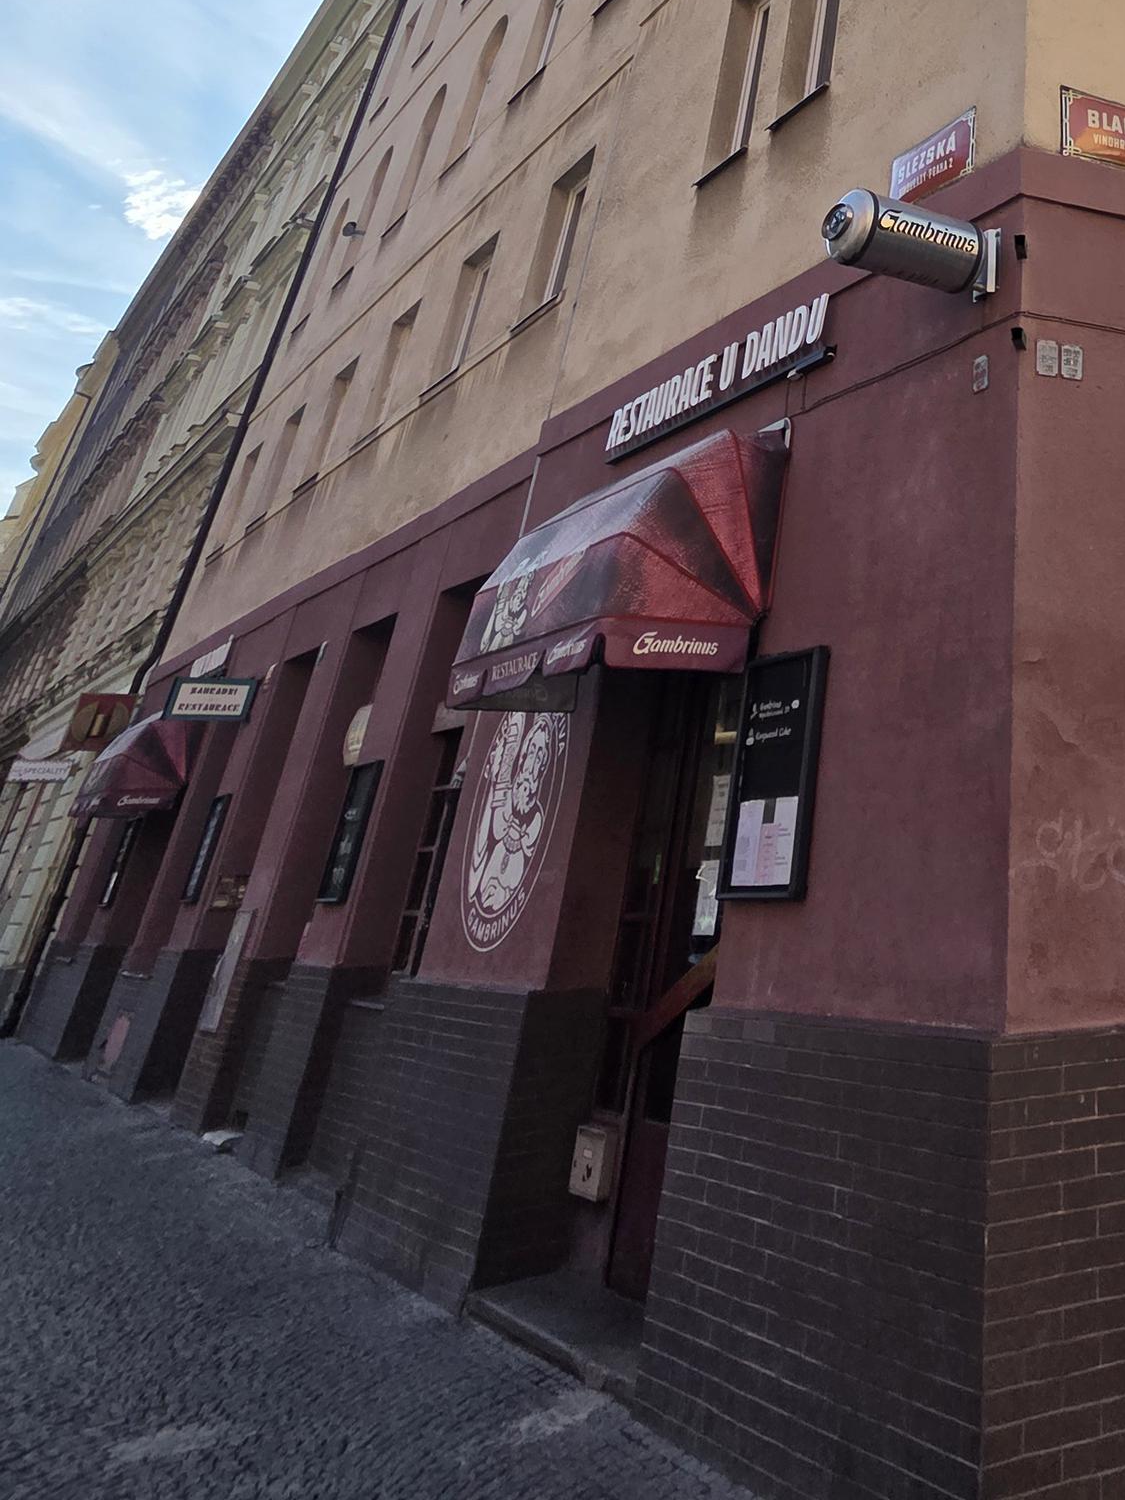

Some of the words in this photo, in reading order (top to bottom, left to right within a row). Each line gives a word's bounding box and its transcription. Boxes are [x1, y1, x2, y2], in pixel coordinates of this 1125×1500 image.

[878, 209, 976, 252] Gambrinus
[605, 354, 717, 451] RESTAURACE
[719, 342, 739, 391] U
[633, 631, 718, 655] Gambrinus
[491, 652, 538, 681] RESTAURACE
[467, 887, 525, 942] GAMBRINUS
